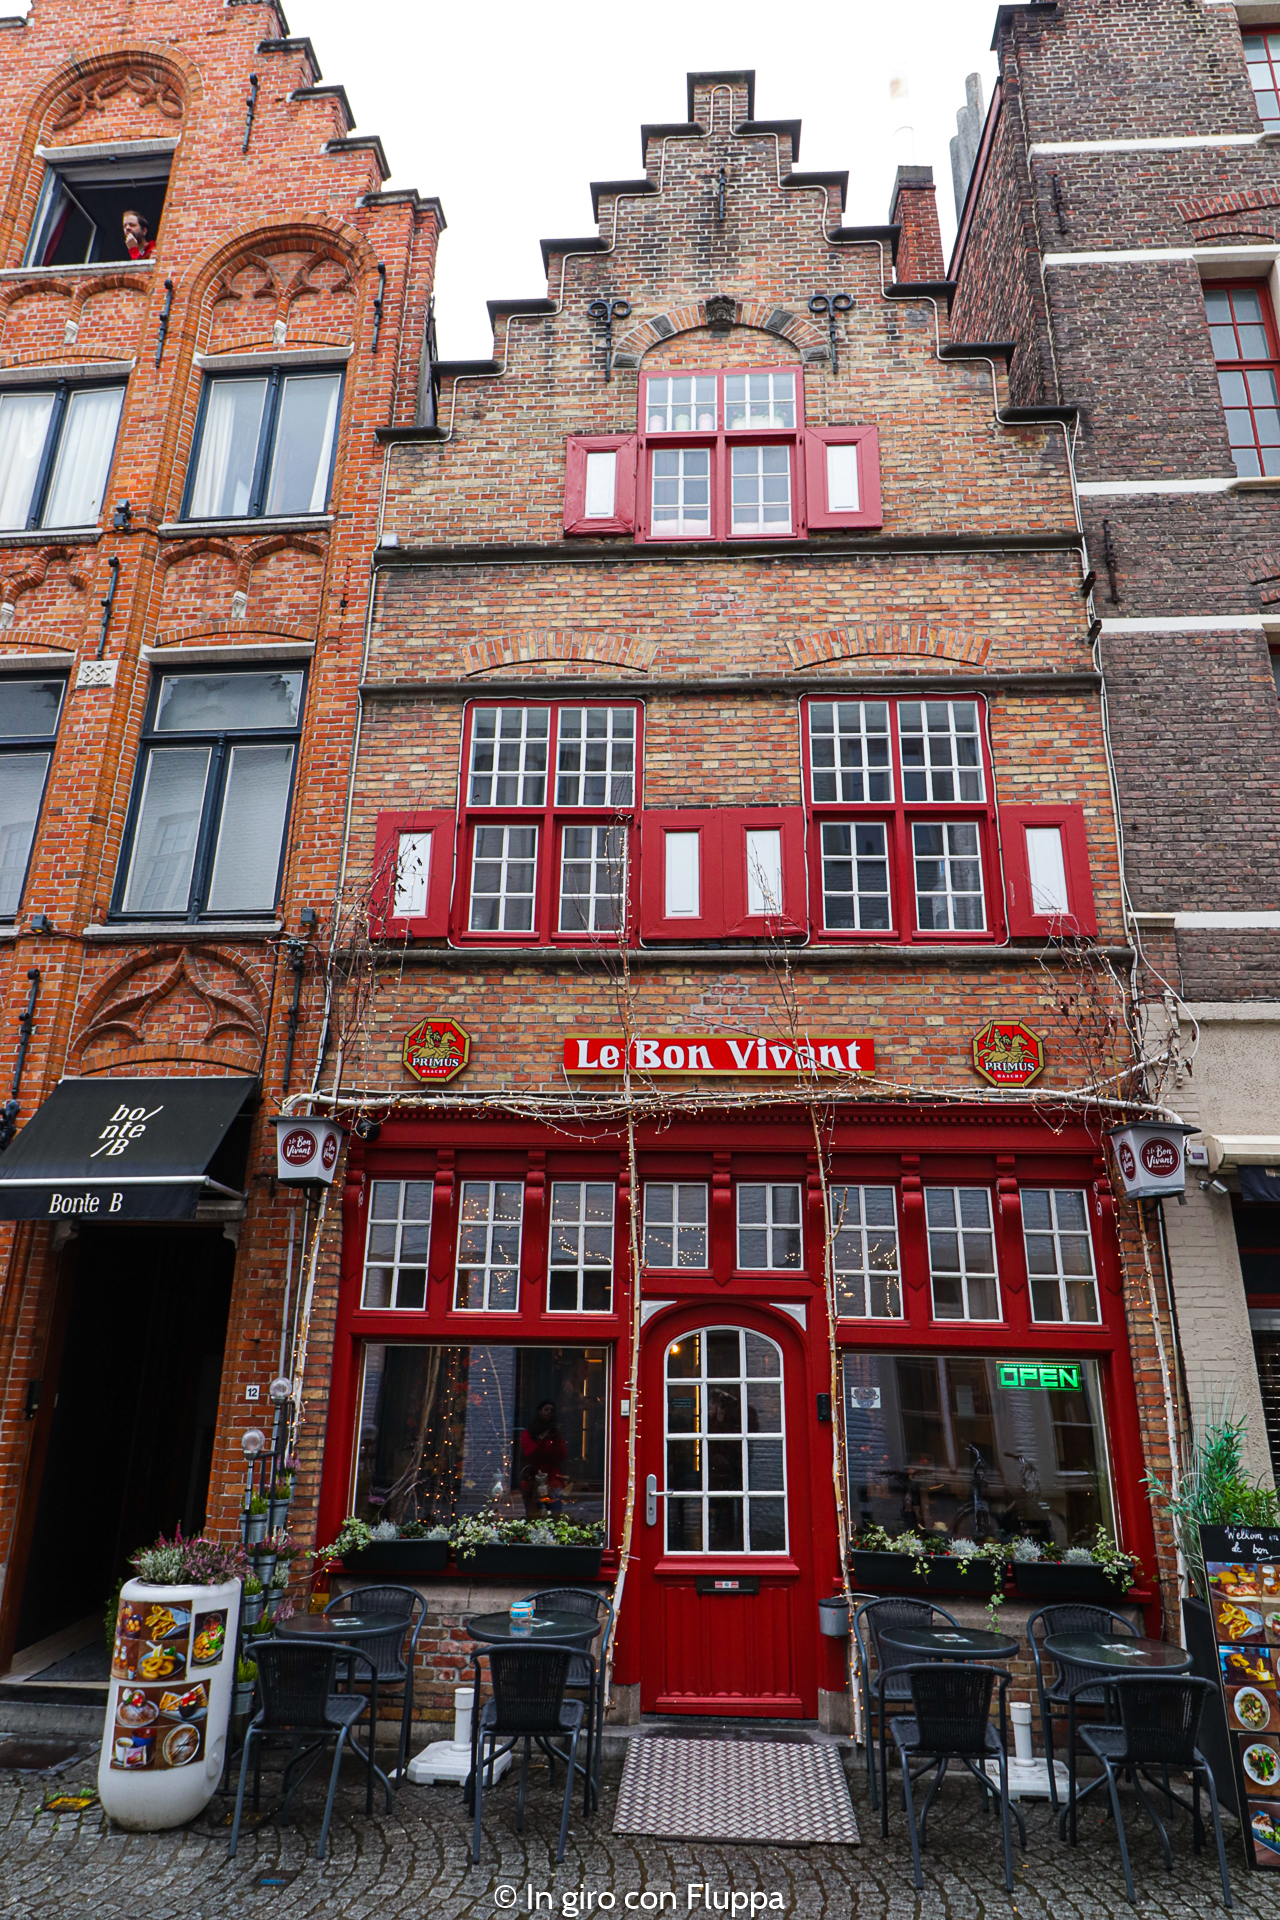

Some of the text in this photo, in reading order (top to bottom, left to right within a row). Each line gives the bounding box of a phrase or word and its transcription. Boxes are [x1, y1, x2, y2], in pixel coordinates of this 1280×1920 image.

[576, 1037, 862, 1070] Le Bon Vivant
[412, 1057, 459, 1067] PRIMUS
[985, 1062, 1035, 1072] PRIMUS
[98, 1121, 147, 1139] nte
[296, 1135, 312, 1148] Bon
[286, 1145, 312, 1158] Vivant
[1155, 1144, 1173, 1158] Bon
[1146, 1154, 1174, 1169] Vivant
[48, 1192, 123, 1214] Bonte B
[1000, 1367, 1078, 1388] OPEN
[247, 1387, 258, 1397] 12
